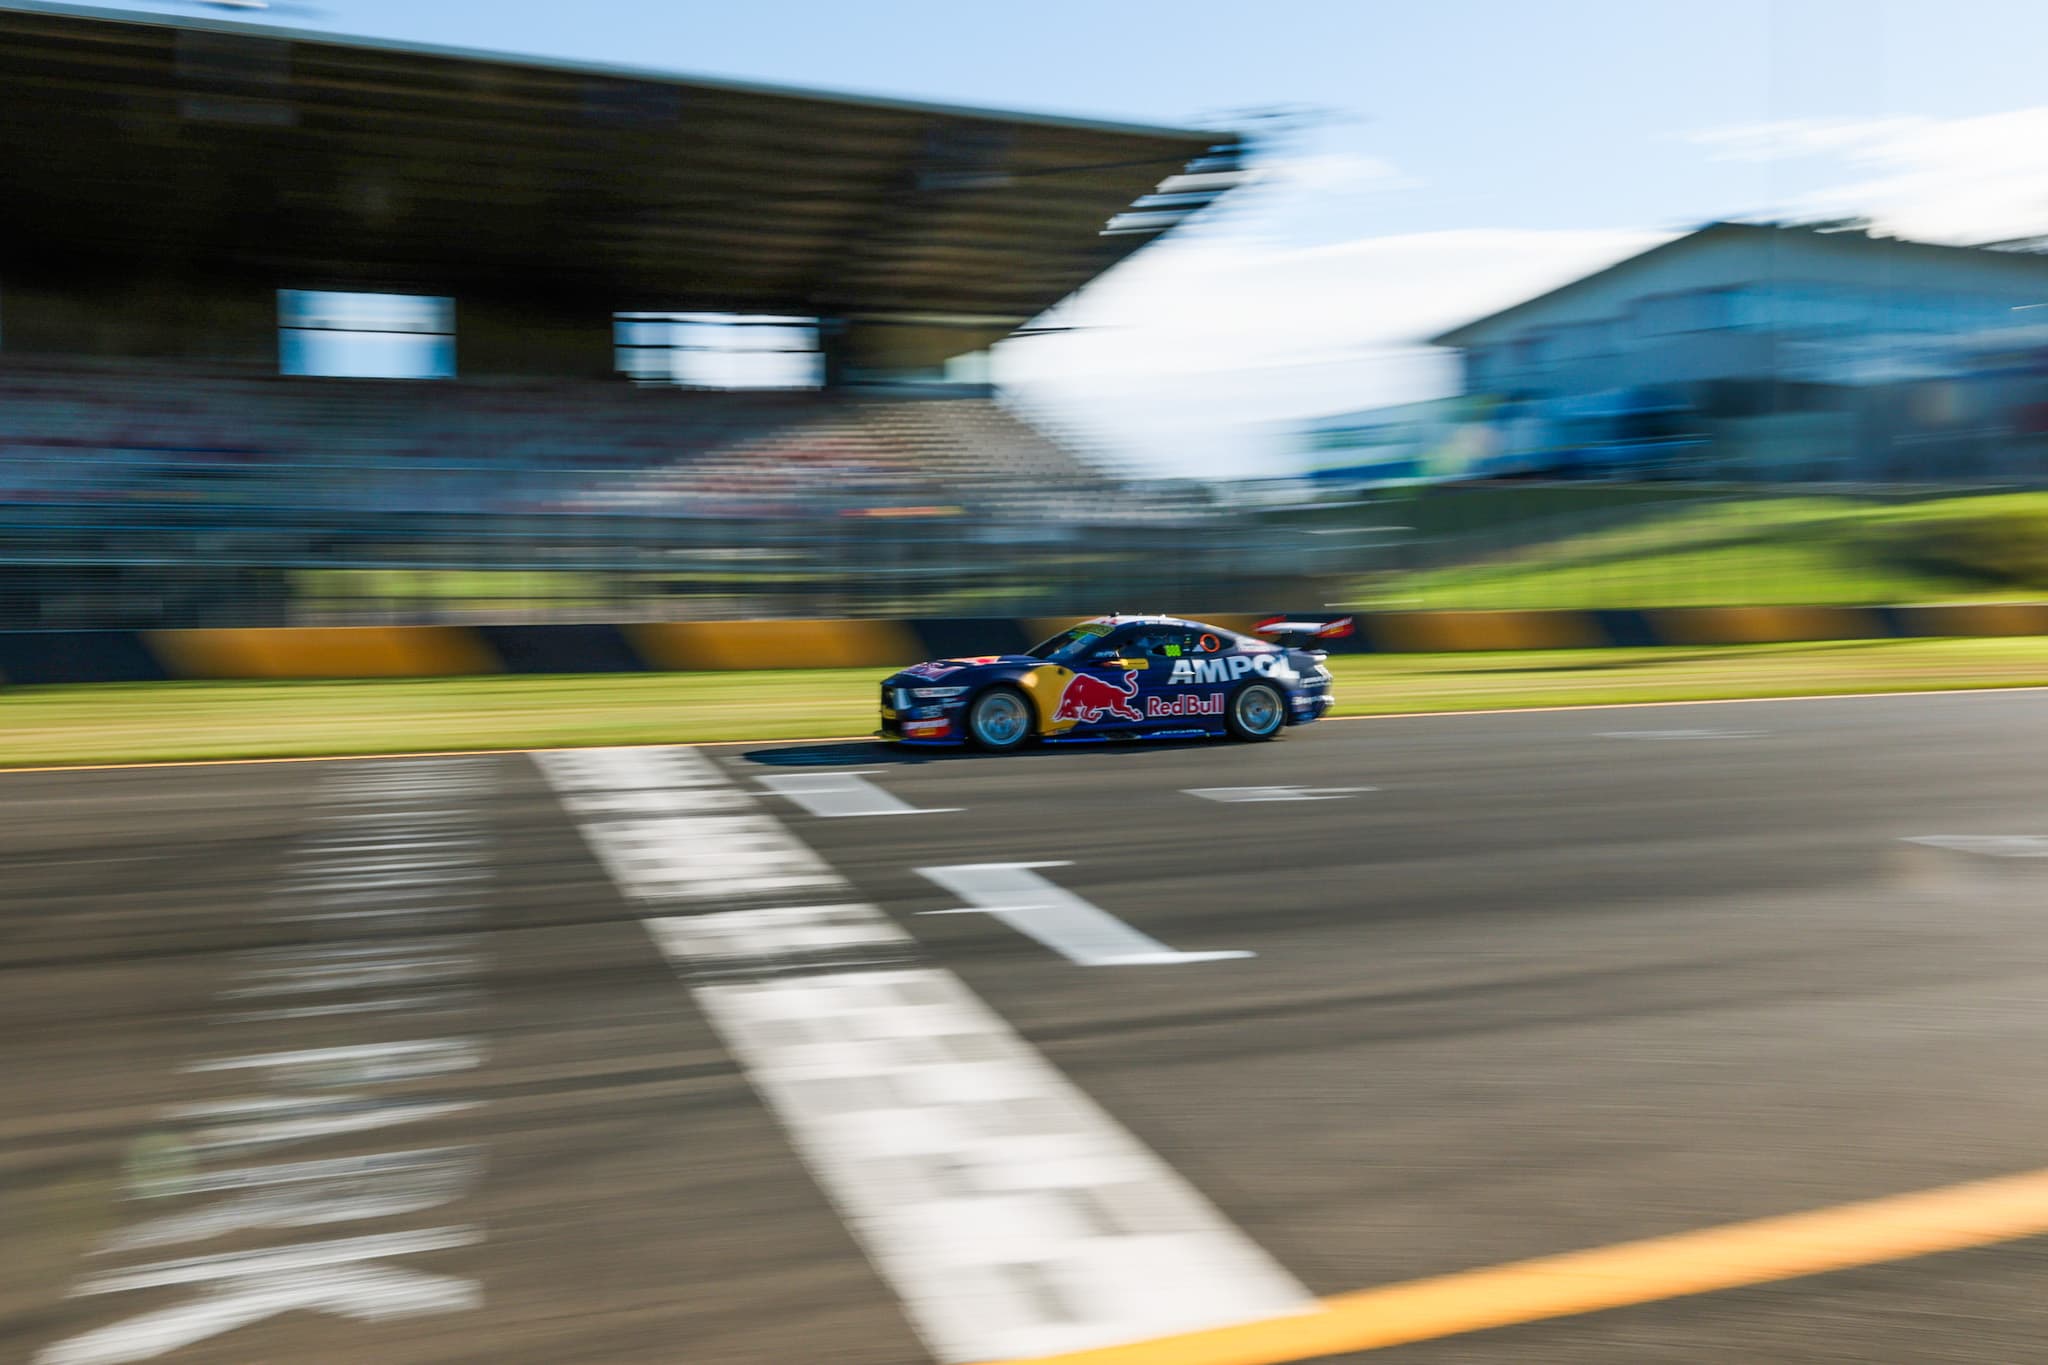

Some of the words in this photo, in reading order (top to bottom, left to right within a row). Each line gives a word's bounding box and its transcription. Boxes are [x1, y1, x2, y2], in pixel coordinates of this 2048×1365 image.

[1168, 654, 1300, 685] AMPOL
[1147, 694, 1185, 717] Red
[1186, 693, 1225, 715] Bull
